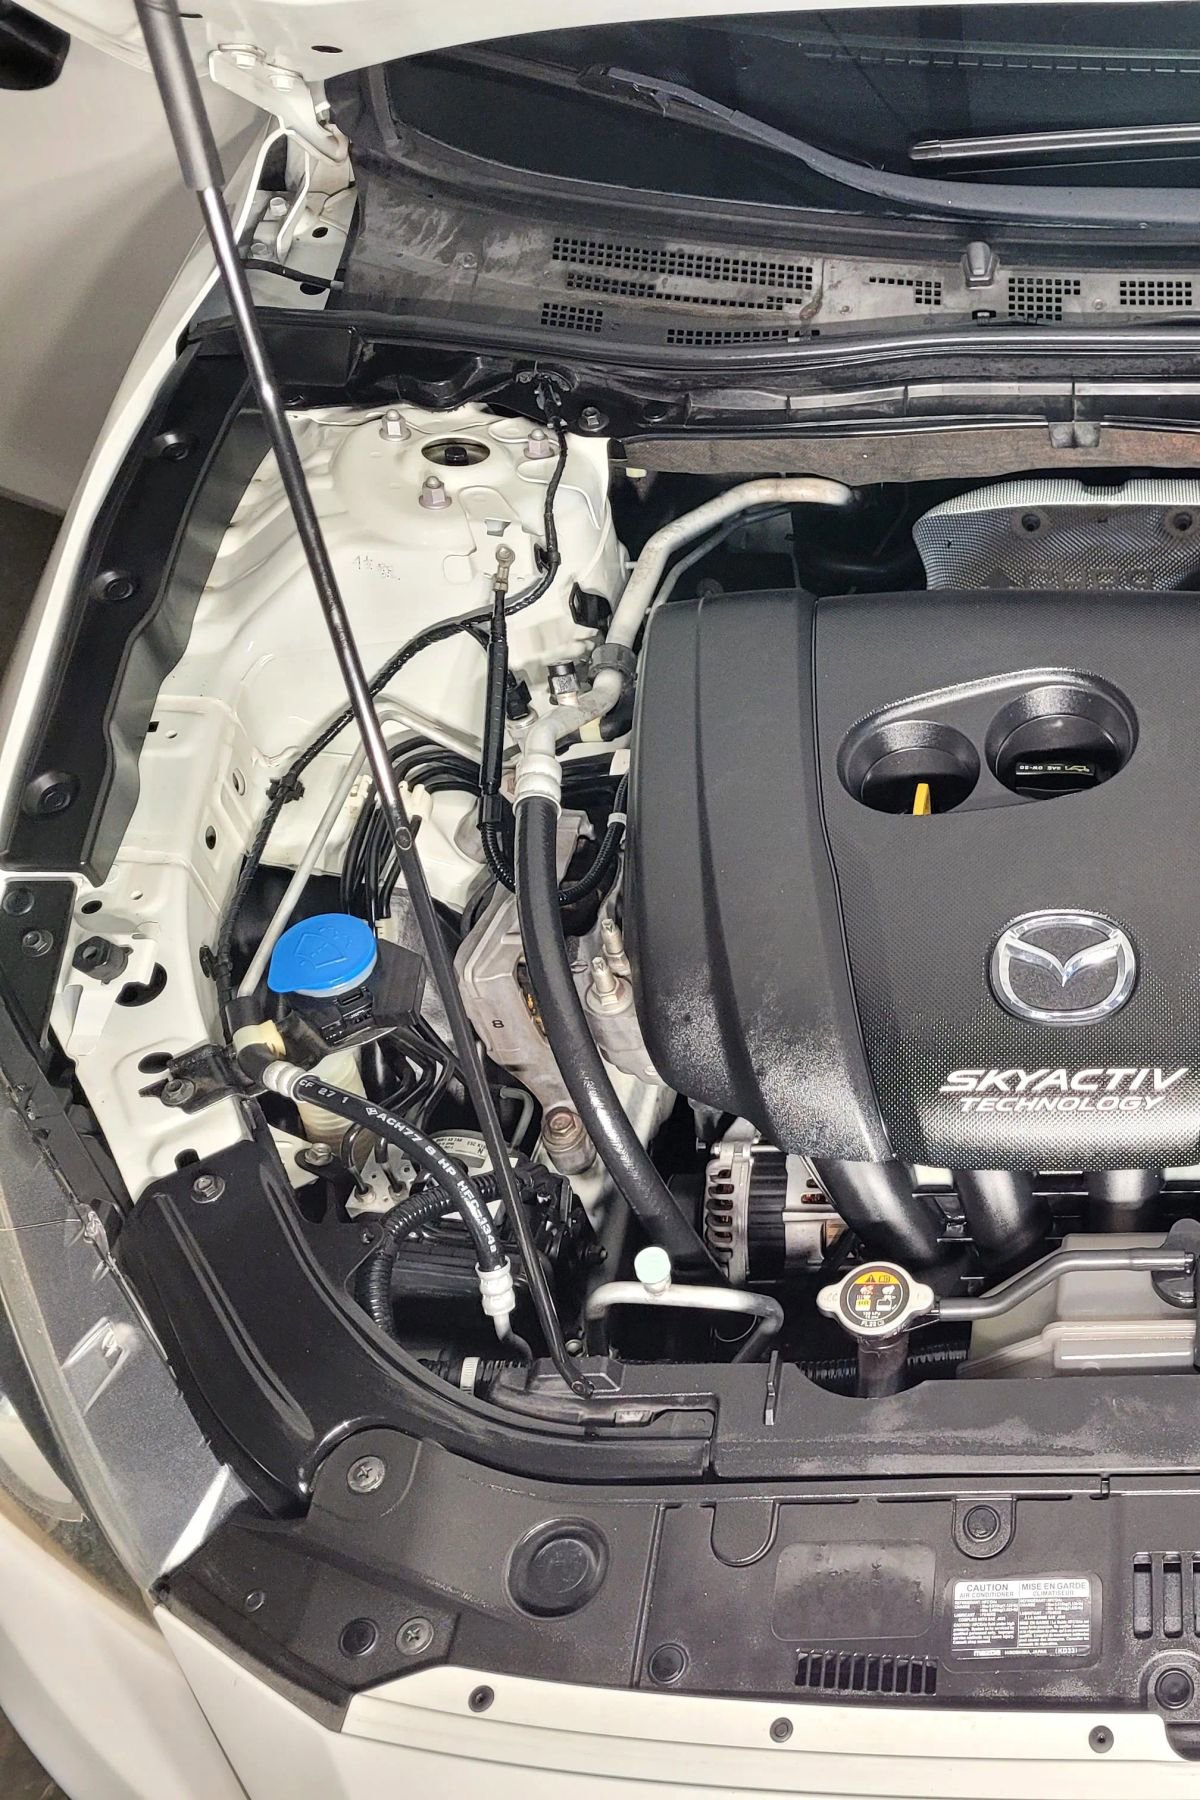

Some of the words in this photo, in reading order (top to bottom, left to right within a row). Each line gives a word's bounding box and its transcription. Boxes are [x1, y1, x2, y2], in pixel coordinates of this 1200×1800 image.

[938, 1067, 1189, 1092] SKYACTIV
[961, 1096, 1167, 1112] TECHNOLOGY
[317, 1087, 337, 1098] 27
[437, 1158, 457, 1176] HP
[966, 1584, 1009, 1592] CAUTION
[1021, 1583, 1041, 1591] MISE
[1043, 1582, 1057, 1590] EN
[1057, 1582, 1086, 1590] GARDE
